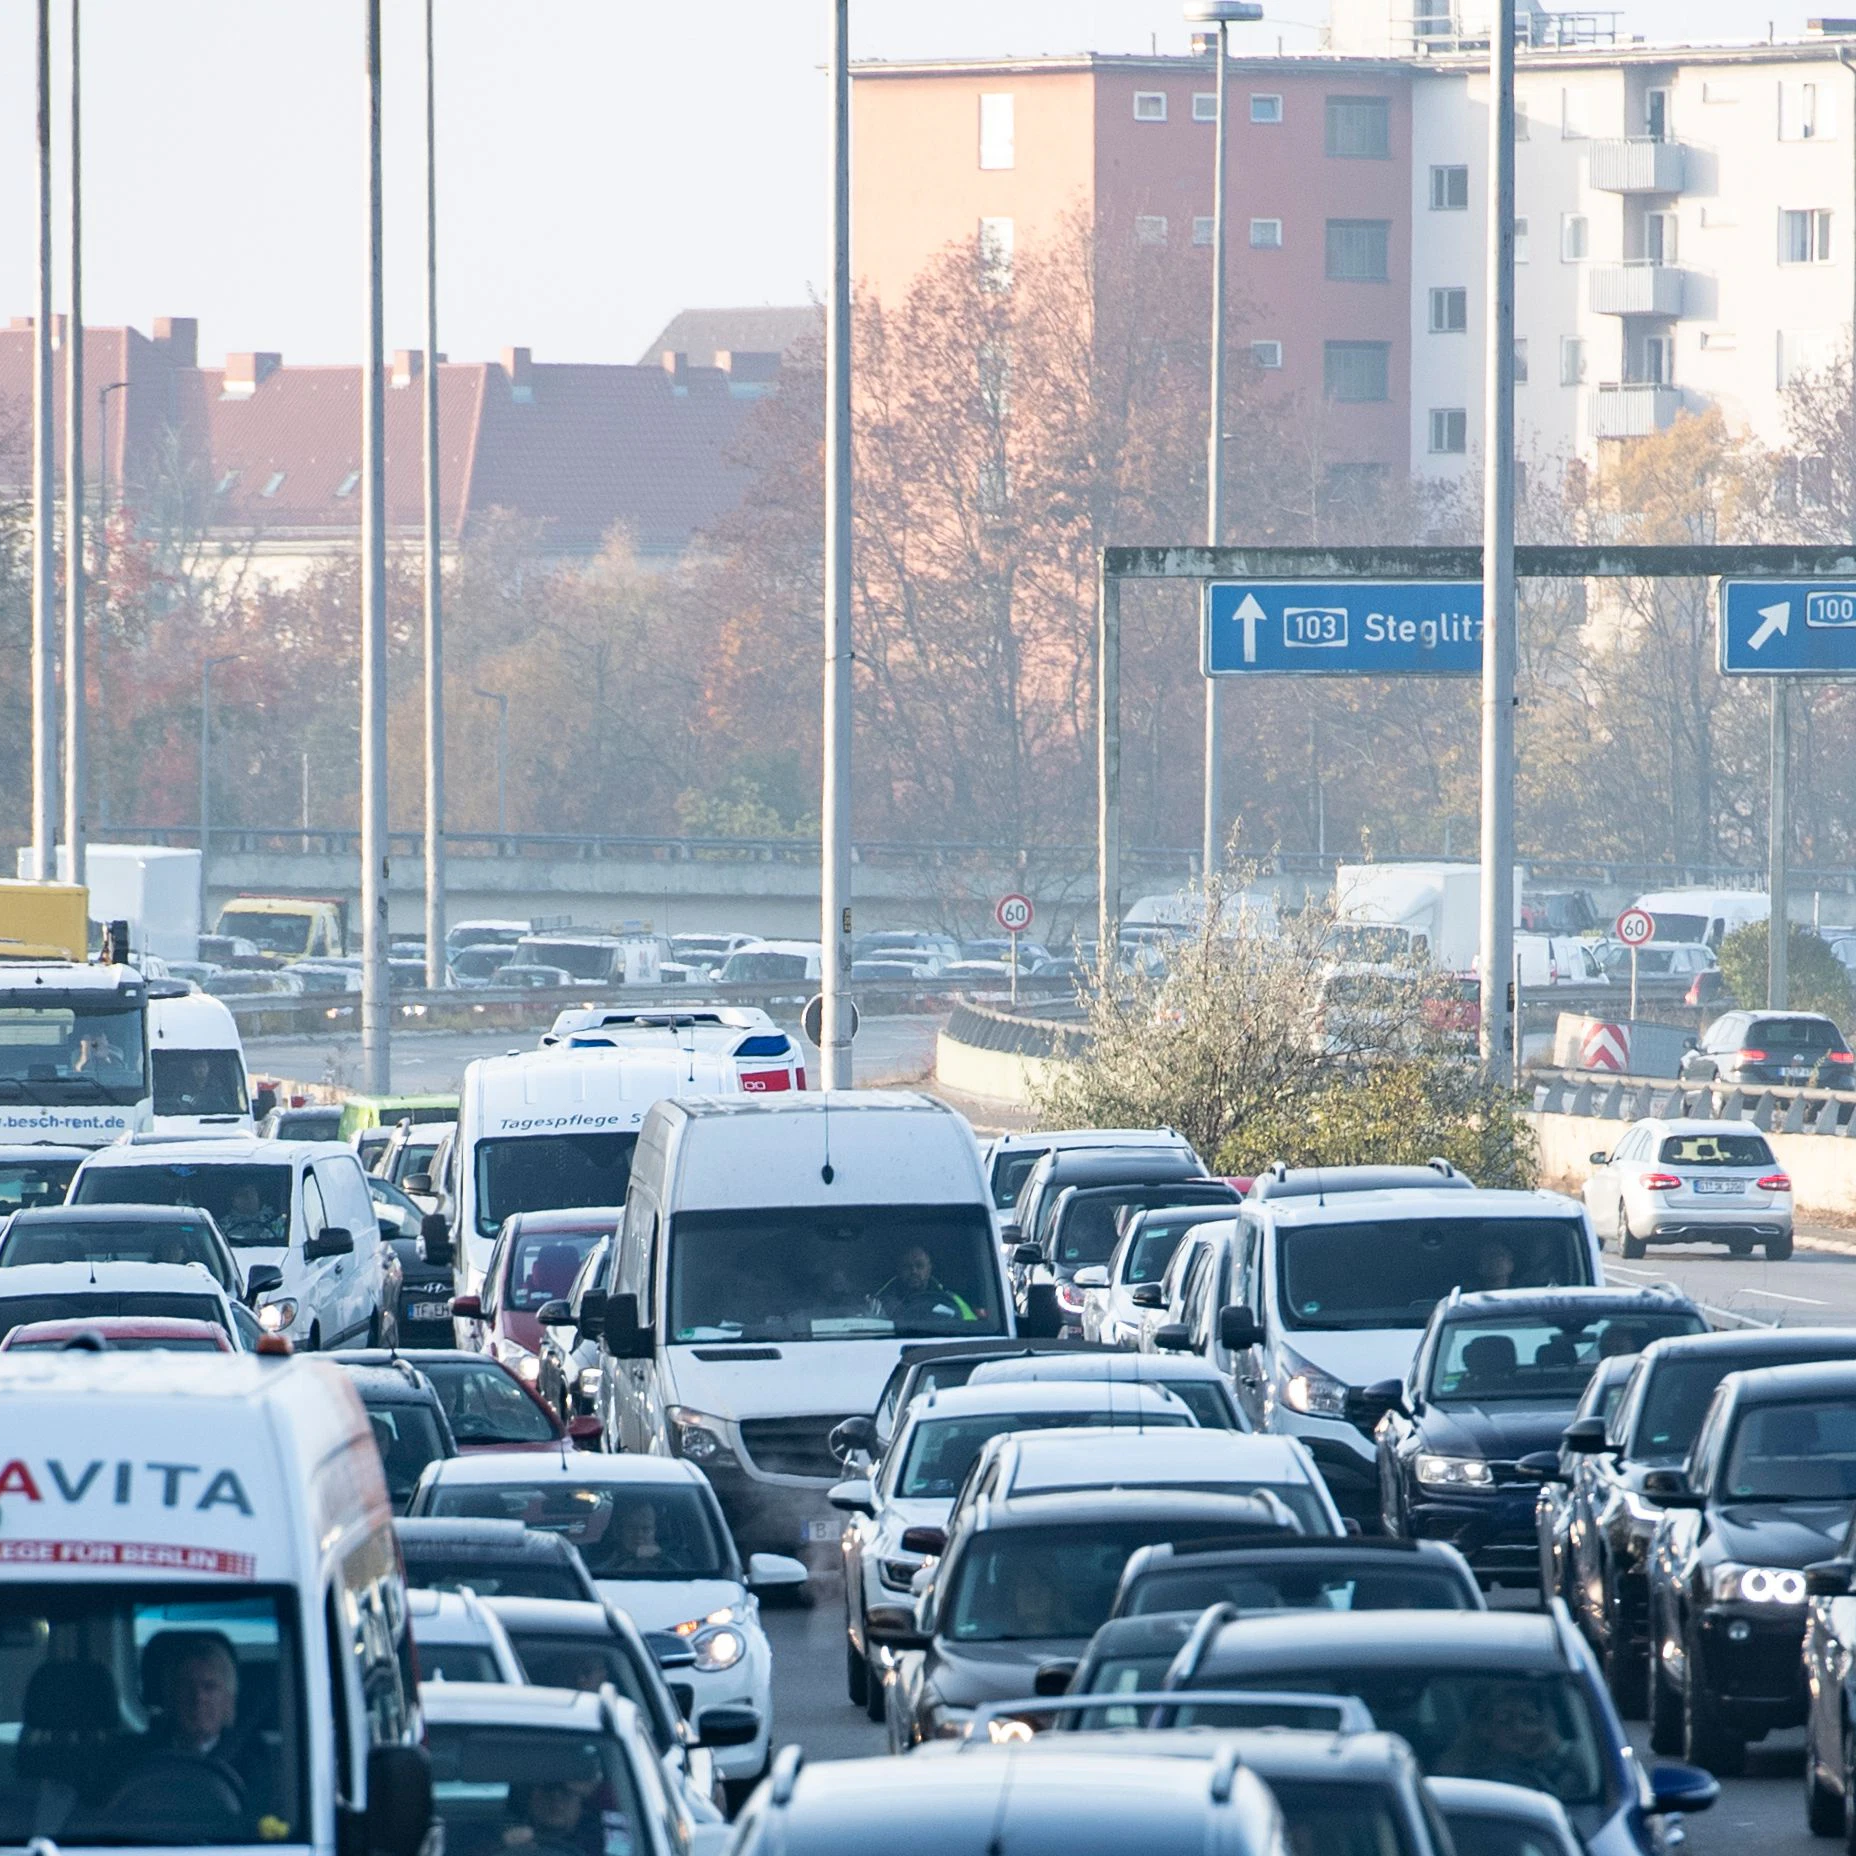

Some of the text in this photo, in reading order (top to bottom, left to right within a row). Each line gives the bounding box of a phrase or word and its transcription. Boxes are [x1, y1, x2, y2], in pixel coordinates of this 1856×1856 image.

[1816, 599, 1854, 620] 100
[1295, 615, 1337, 640] 103
[1005, 904, 1025, 921] 60
[1624, 919, 1644, 936] 60
[500, 1113, 619, 1131] Tagespflege
[63, 1543, 113, 1563] FÜR
[122, 1545, 217, 1572] BERLIN
